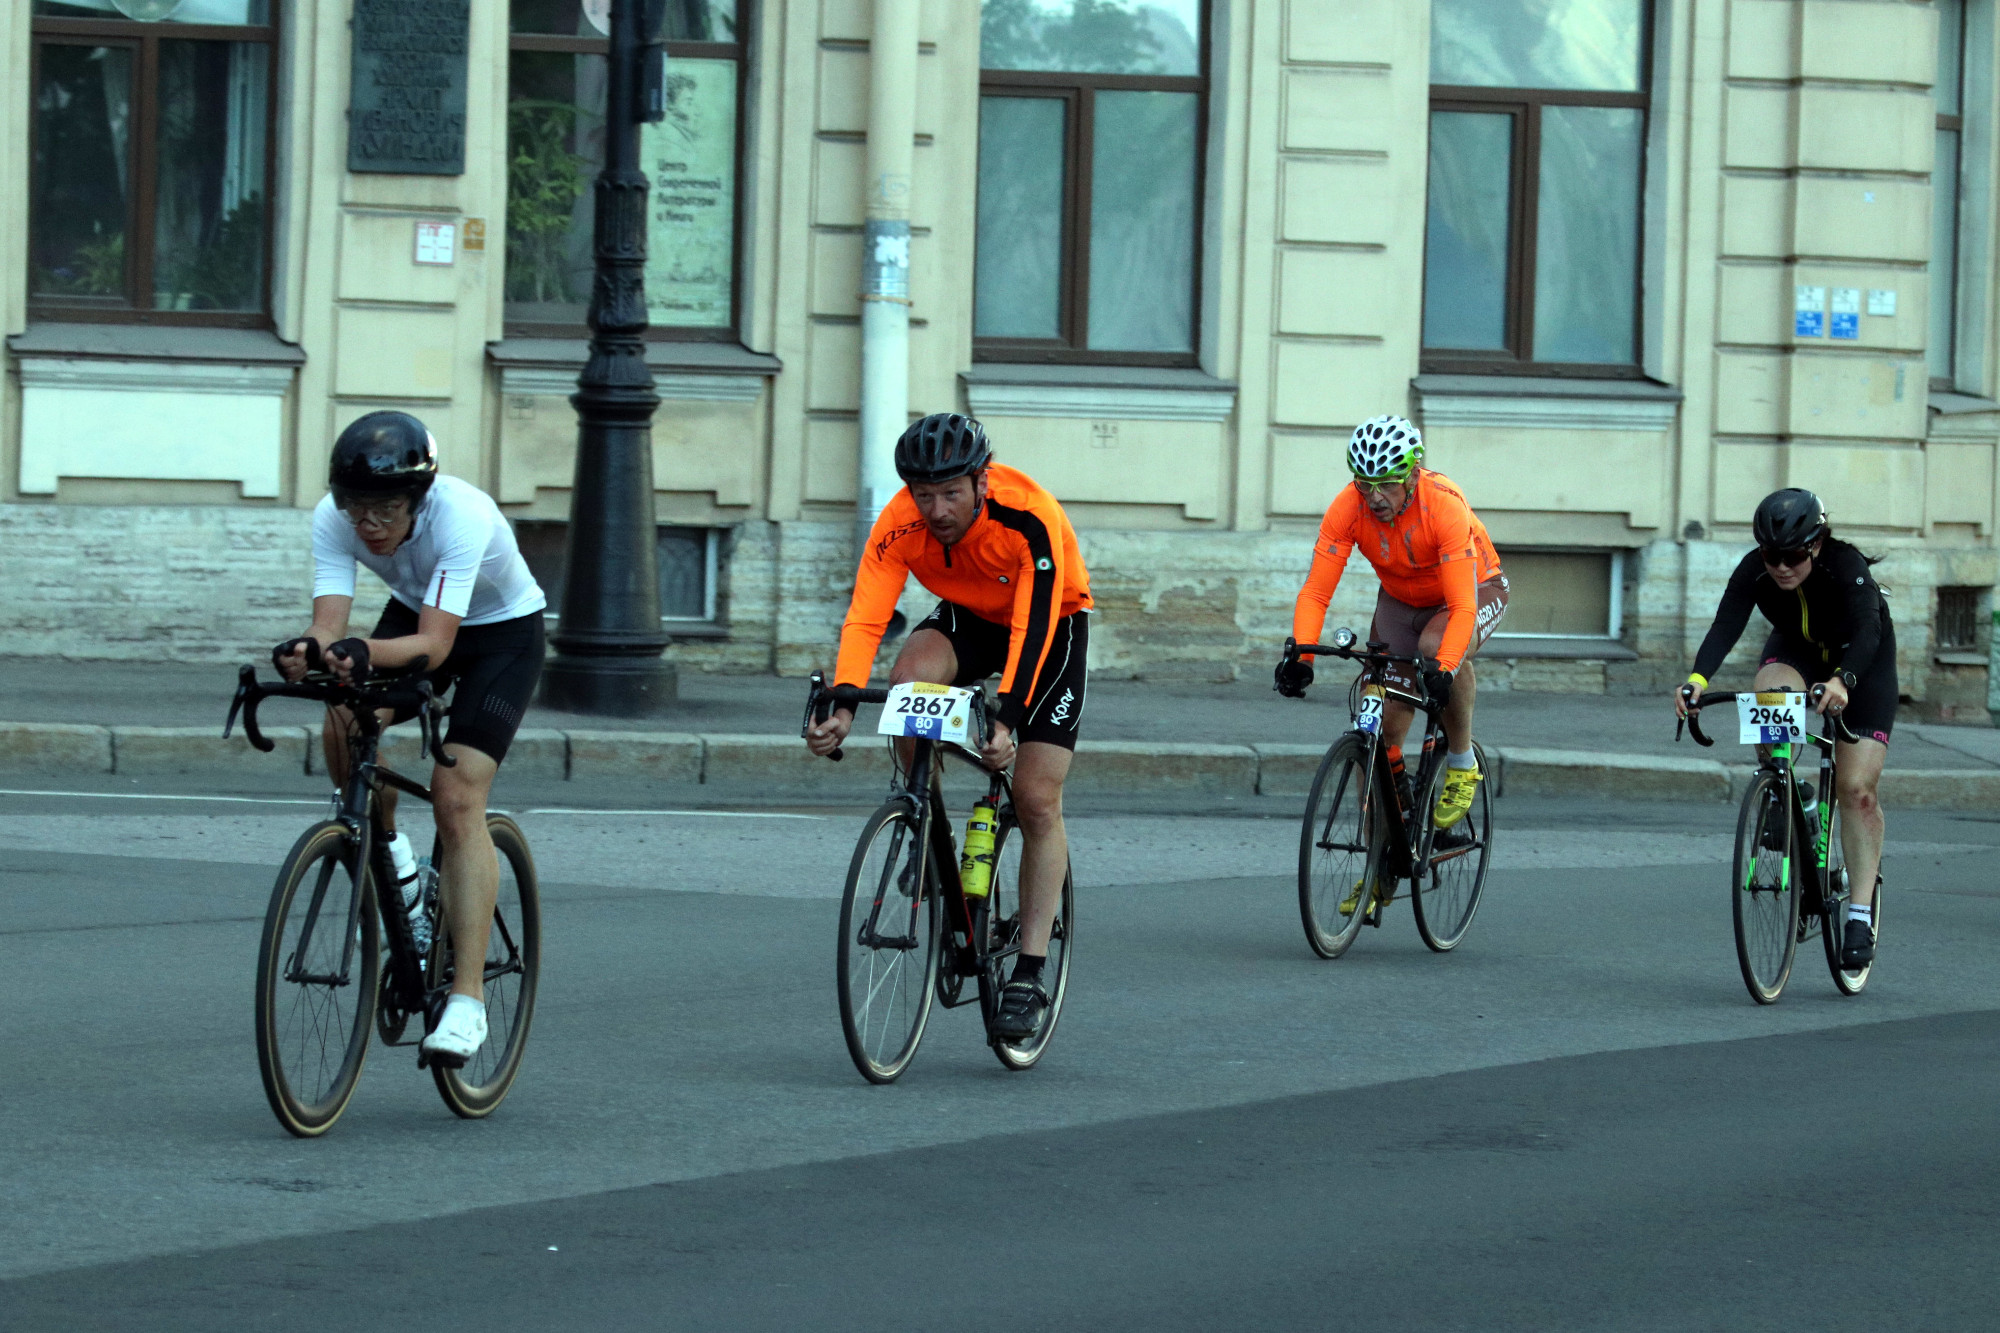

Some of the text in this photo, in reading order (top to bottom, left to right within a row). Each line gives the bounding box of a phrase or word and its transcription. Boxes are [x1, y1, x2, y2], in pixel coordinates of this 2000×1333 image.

[896, 696, 957, 717] 2867
[1360, 714, 1374, 725] 80
[1749, 707, 1795, 725] 2964
[915, 717, 933, 730] 80
[1768, 726, 1782, 736] 80
